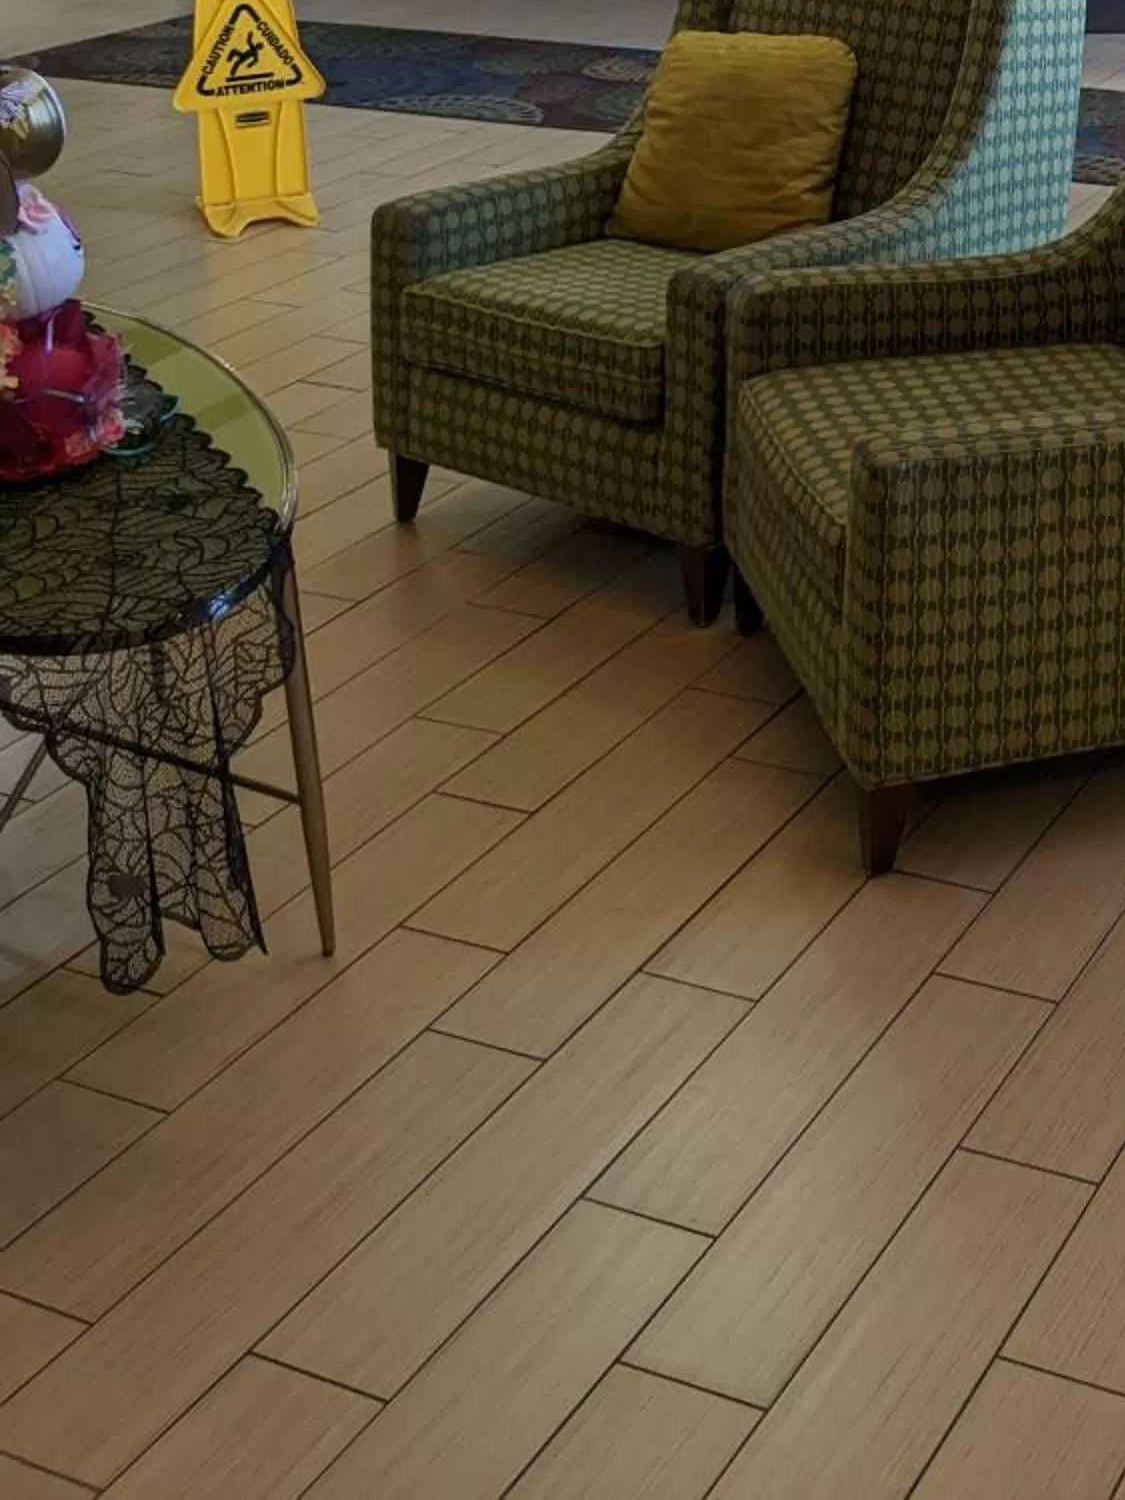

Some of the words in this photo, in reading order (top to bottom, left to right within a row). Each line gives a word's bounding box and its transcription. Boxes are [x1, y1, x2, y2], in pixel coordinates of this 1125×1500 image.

[202, 24, 235, 75] CAUTION
[257, 21, 294, 65] CUIDADO
[215, 80, 285, 96] ATTENTION
